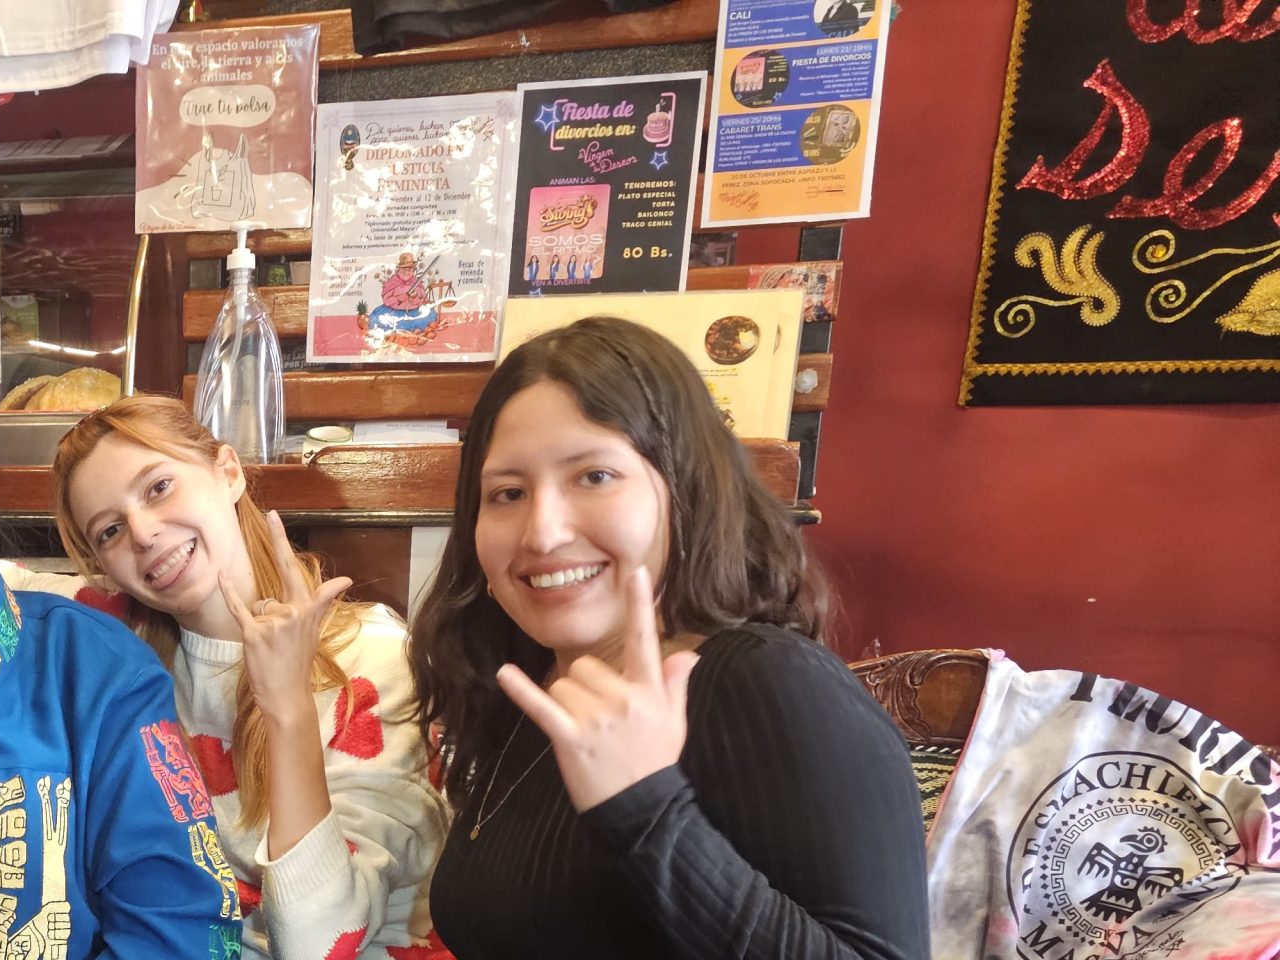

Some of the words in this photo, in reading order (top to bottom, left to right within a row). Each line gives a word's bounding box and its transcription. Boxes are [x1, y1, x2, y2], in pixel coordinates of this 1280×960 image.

[729, 11, 751, 21] CALI
[152, 45, 167, 56] En
[171, 43, 193, 54] ete
[196, 38, 238, 56] espacio
[241, 37, 304, 51] valoramos
[161, 59, 171, 69] el
[175, 57, 201, 69] ire,
[218, 54, 252, 67] tierra
[255, 56, 263, 68] y
[792, 56, 818, 67] FIESTA
[819, 55, 830, 65] DE
[831, 52, 872, 64] DIVORCIOS
[200, 70, 253, 82] animales
[184, 99, 214, 116] Trae
[218, 99, 233, 116] tu
[562, 101, 610, 121] Fiesta
[613, 100, 634, 118] de
[387, 125, 415, 137] quienes
[419, 121, 445, 131] luchan
[555, 123, 613, 140] divorcios
[615, 123, 636, 136] en:
[720, 125, 754, 135] CABARET
[757, 123, 782, 132] TRANS
[579, 140, 615, 163] Virgen
[388, 161, 445, 176] USTICIA
[600, 156, 638, 174] Deseos
[549, 176, 580, 186] ANIMAN
[624, 180, 677, 189] TENDREMOS:
[434, 192, 442, 202] de
[443, 192, 471, 202] Diciembre
[642, 191, 676, 199] ESPECIAL
[638, 210, 674, 218] BAILONGO
[647, 220, 673, 228] GENIAL
[528, 234, 604, 247] SOMOS
[532, 247, 552, 256] EL
[553, 246, 597, 255] RITMO
[623, 247, 643, 259] 80
[650, 246, 673, 258] Bs.
[458, 260, 474, 268] Becas
[477, 259, 484, 268] de
[460, 268, 484, 276] vivienda
[462, 276, 483, 285] comida
[531, 279, 545, 287] VEN
